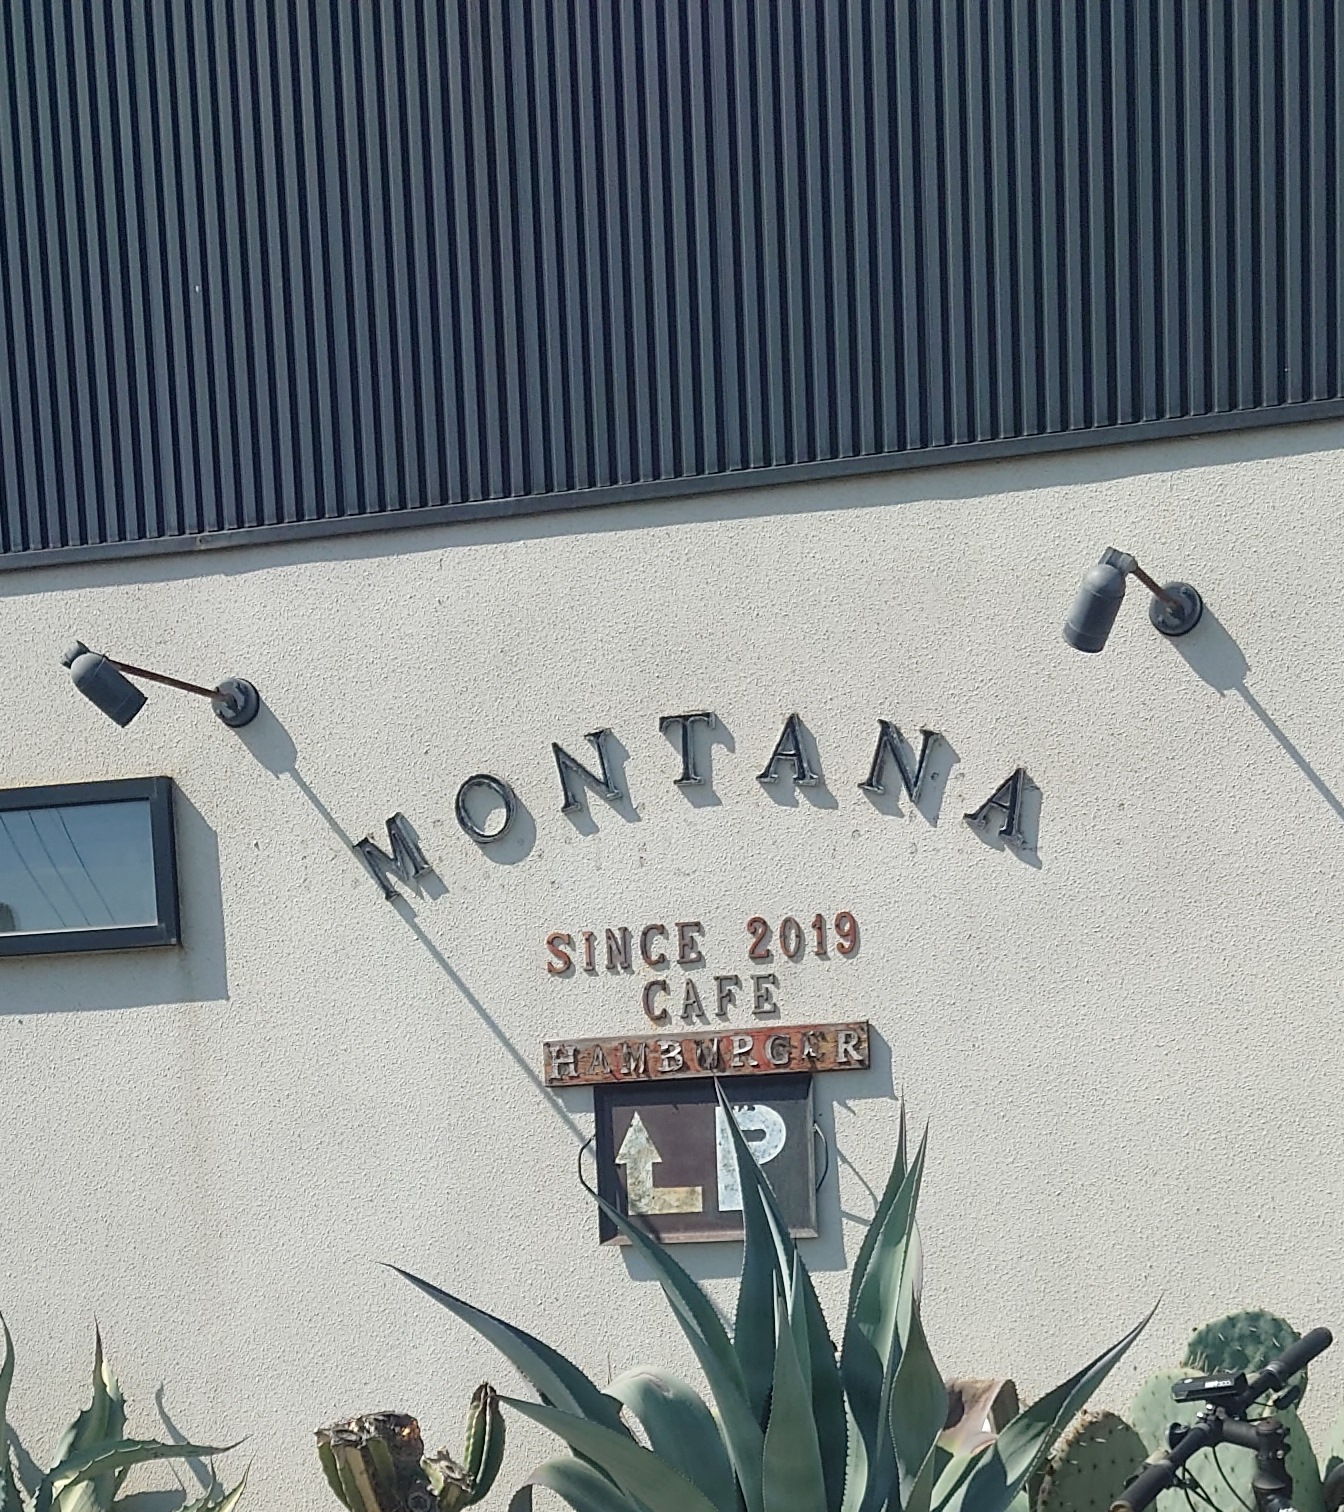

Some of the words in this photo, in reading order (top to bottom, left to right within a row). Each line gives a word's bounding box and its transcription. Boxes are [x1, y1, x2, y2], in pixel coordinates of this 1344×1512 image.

[355, 711, 1038, 901] MONTANA
[545, 920, 704, 976] SINCE
[746, 910, 858, 960] 2019
[641, 972, 780, 1022] CAFE
[715, 1103, 787, 1212] P
